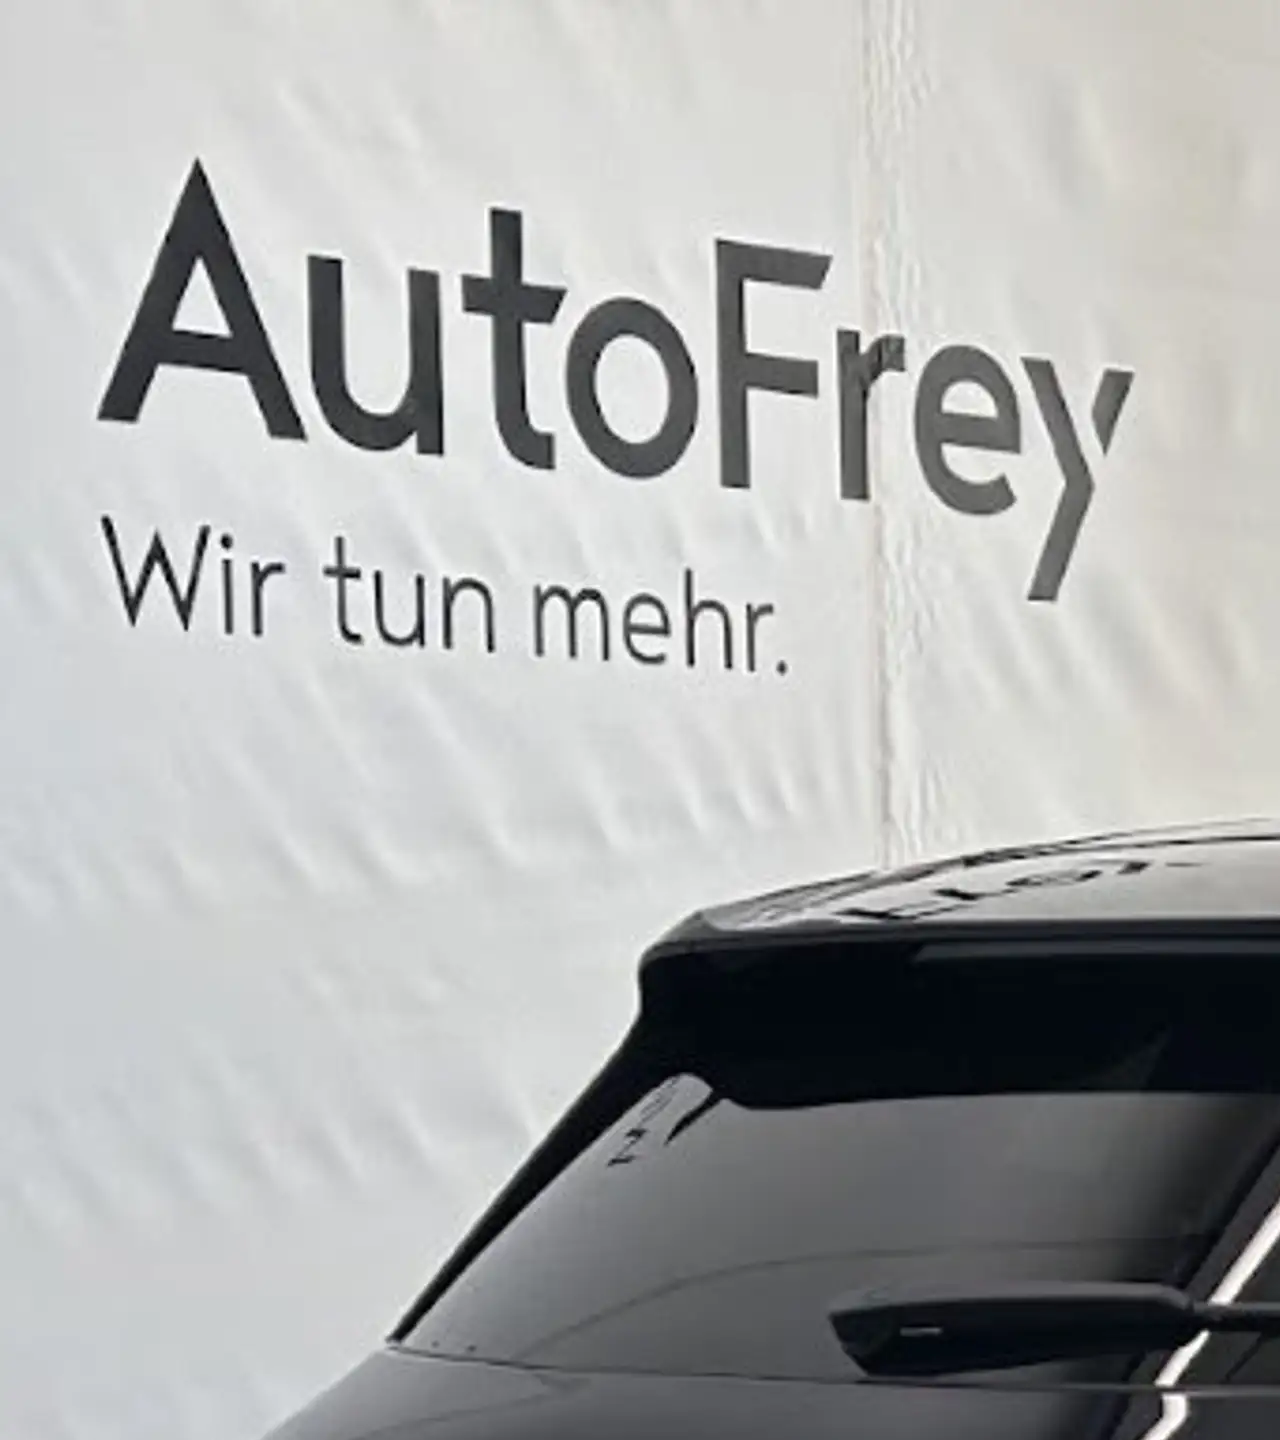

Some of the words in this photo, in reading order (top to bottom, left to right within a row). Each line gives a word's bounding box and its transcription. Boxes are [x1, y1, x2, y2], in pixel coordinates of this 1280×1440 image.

[97, 156, 1135, 603] AutoFrey
[100, 515, 286, 637] Wir
[322, 536, 496, 655] tun
[533, 569, 788, 675] mehr.
